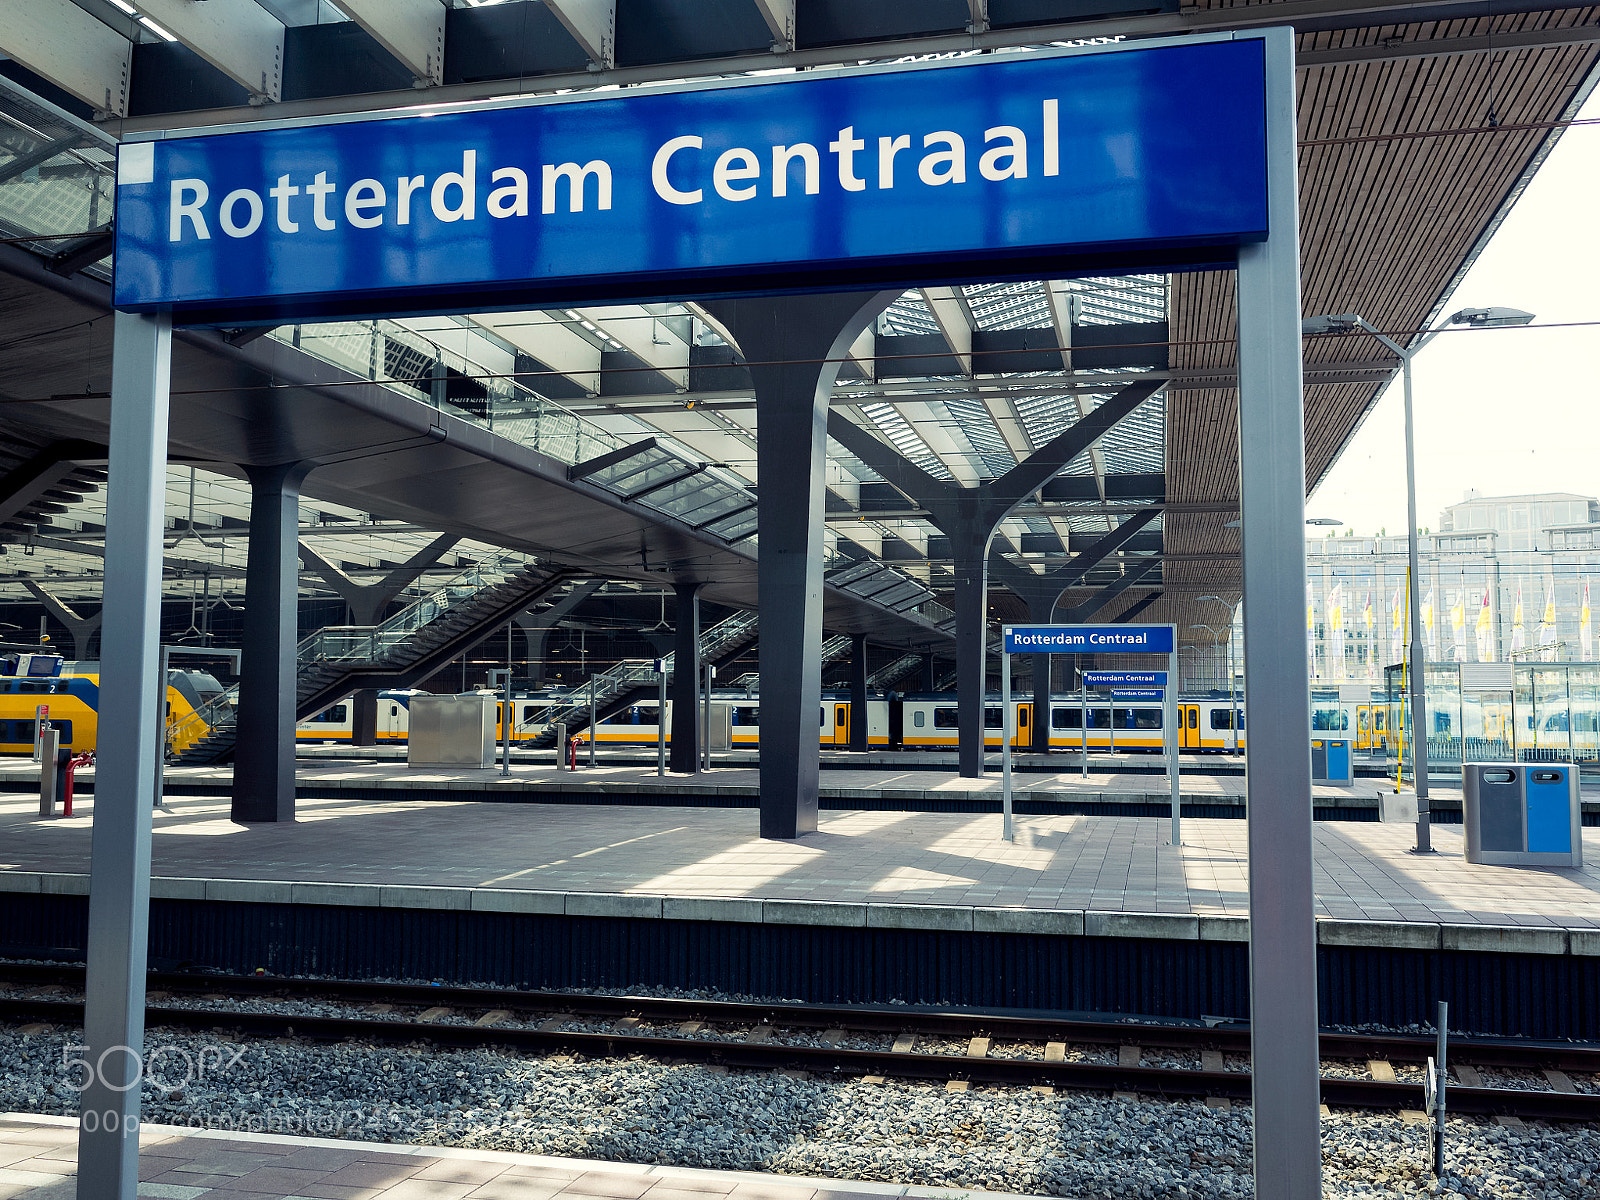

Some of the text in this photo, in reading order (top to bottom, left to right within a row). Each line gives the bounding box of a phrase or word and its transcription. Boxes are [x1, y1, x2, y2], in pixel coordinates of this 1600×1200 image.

[167, 98, 1062, 242] Rotterdam Centraal
[1014, 632, 1147, 645] Rotterdam Centraal
[1087, 674, 1155, 682] Rotterdam Centraal
[50, 685, 56, 694] 2
[633, 706, 639, 714] 2
[732, 706, 738, 714] 2
